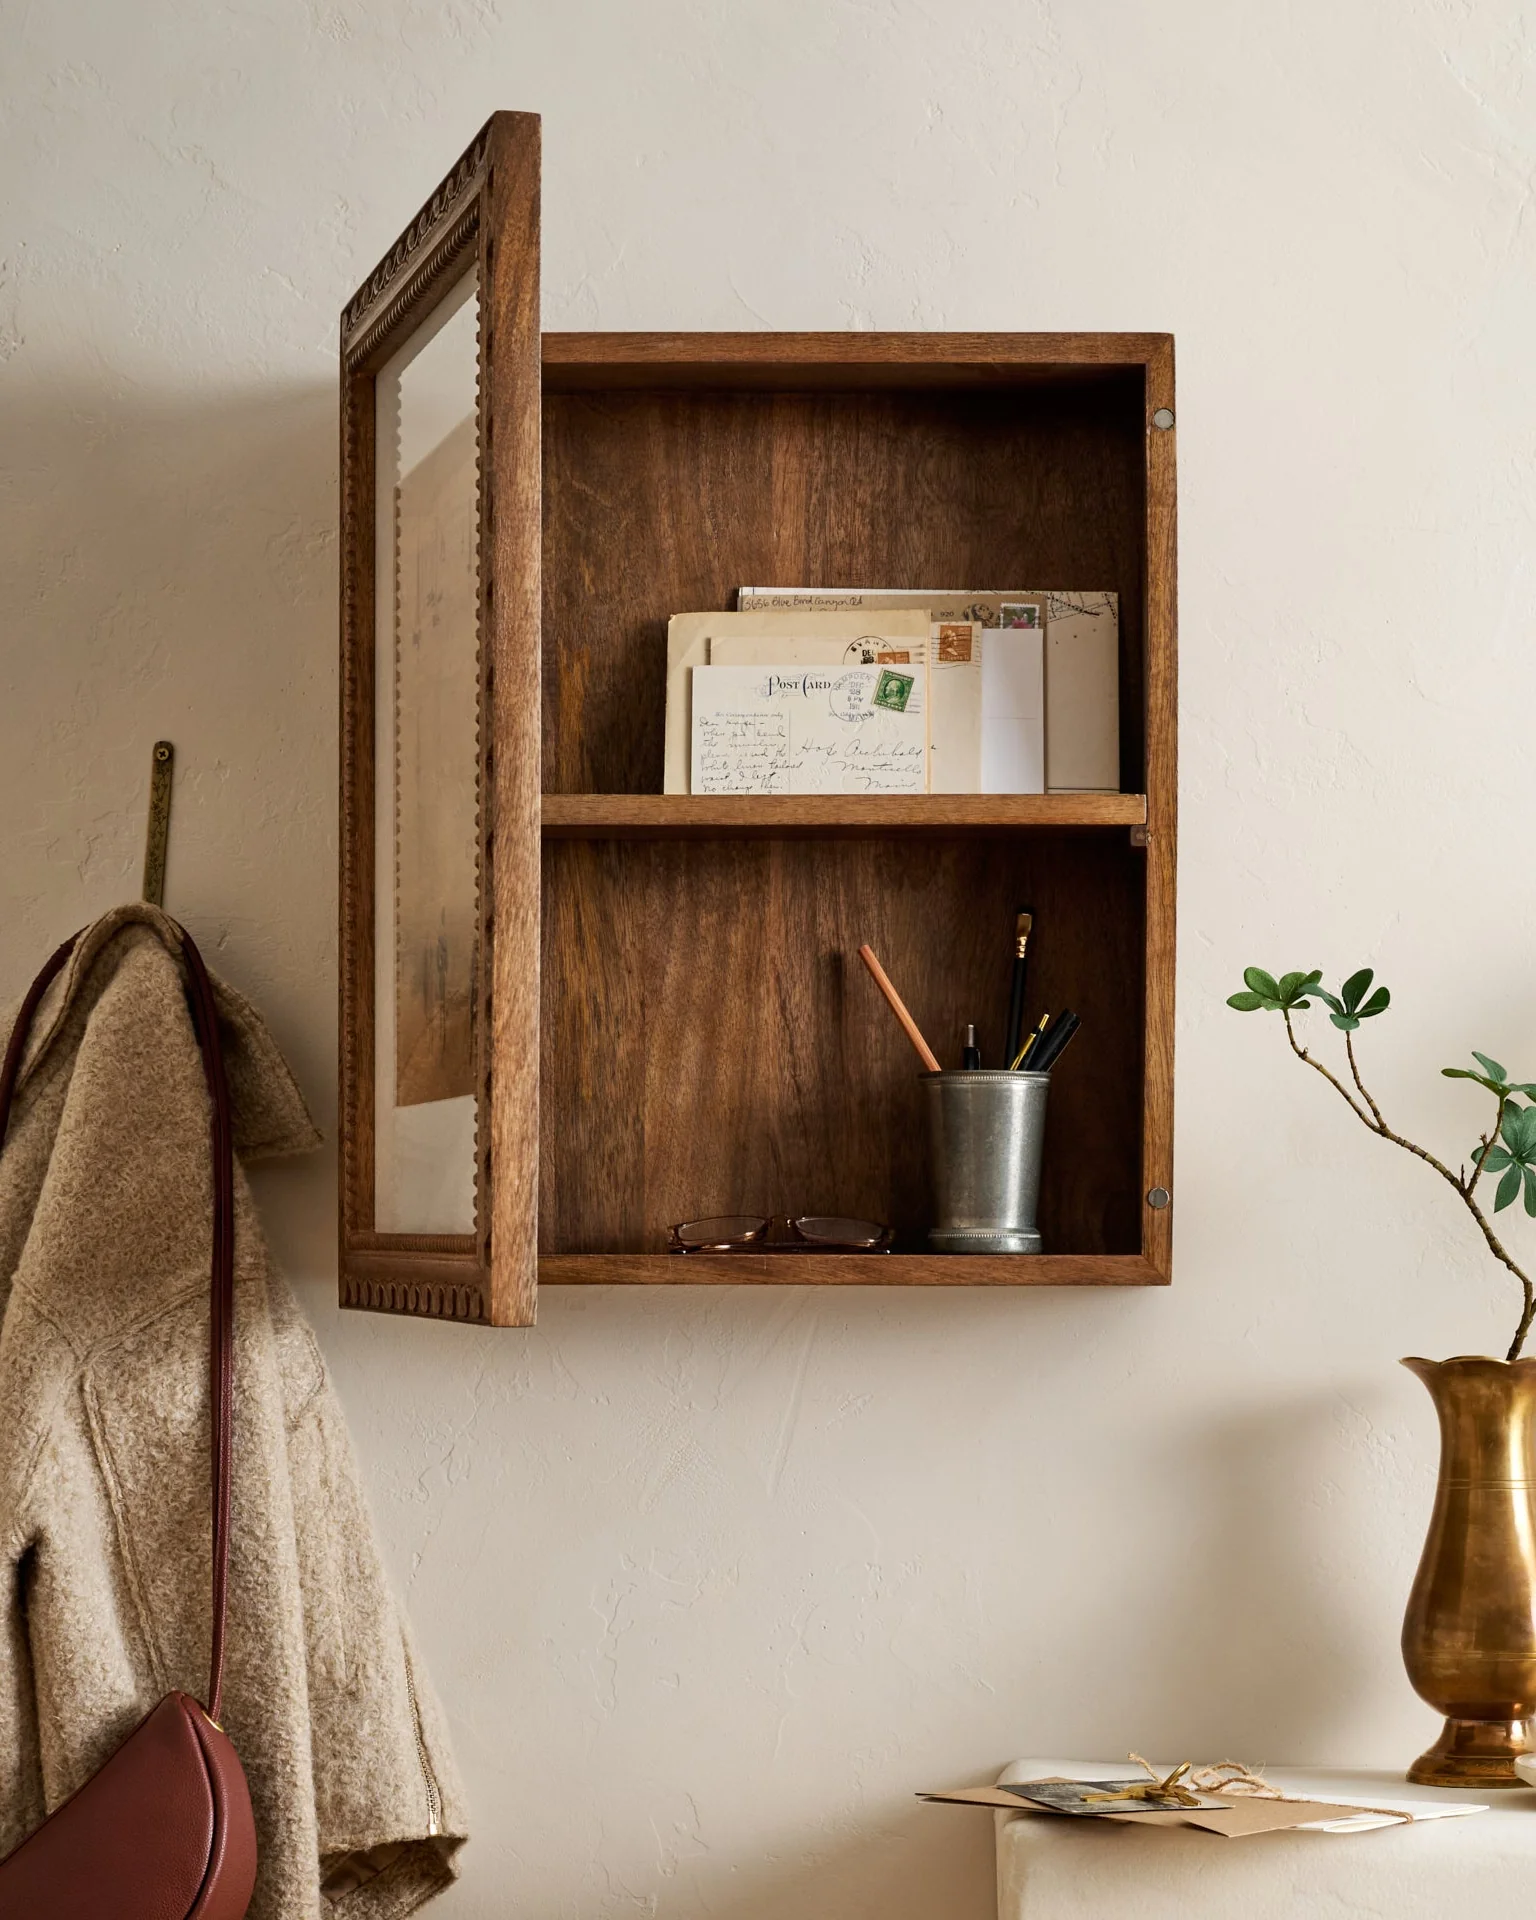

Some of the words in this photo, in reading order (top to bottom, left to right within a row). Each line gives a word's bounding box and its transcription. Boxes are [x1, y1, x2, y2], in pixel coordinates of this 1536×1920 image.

[772, 597, 791, 606] Blue
[814, 597, 848, 611] Canyon
[768, 675, 799, 697] POST
[802, 674, 831, 698] CARD
